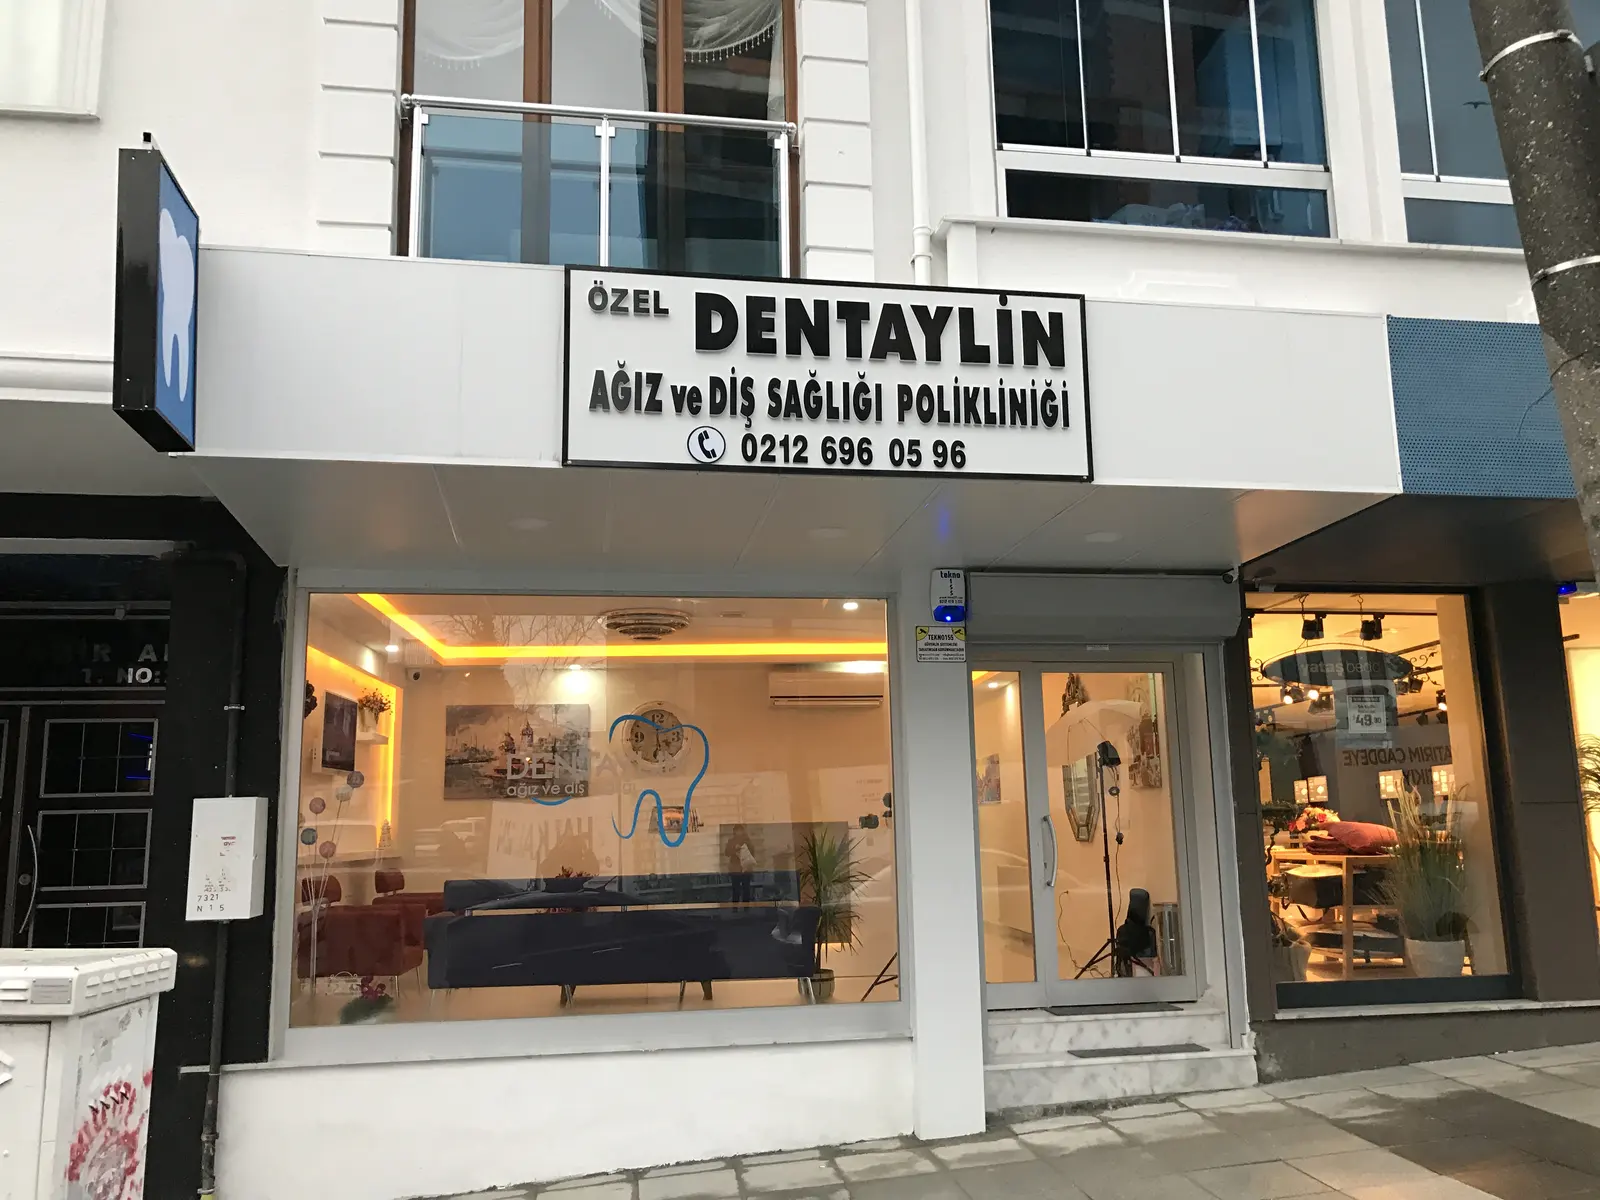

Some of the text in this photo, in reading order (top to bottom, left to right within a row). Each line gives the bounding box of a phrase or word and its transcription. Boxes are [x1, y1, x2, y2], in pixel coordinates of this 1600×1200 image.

[588, 280, 670, 315] ÖZEL
[694, 291, 1067, 368] DENTAYLİN
[588, 360, 1070, 429] AĞIZ ve DİŞ SAĞLIĞI POLİKLİNİĞİ
[741, 433, 967, 470] 0212 696 05 96
[940, 570, 961, 578] tekno
[506, 781, 540, 798] ağız
[542, 784, 561, 794] ve
[564, 781, 586, 796] diş
